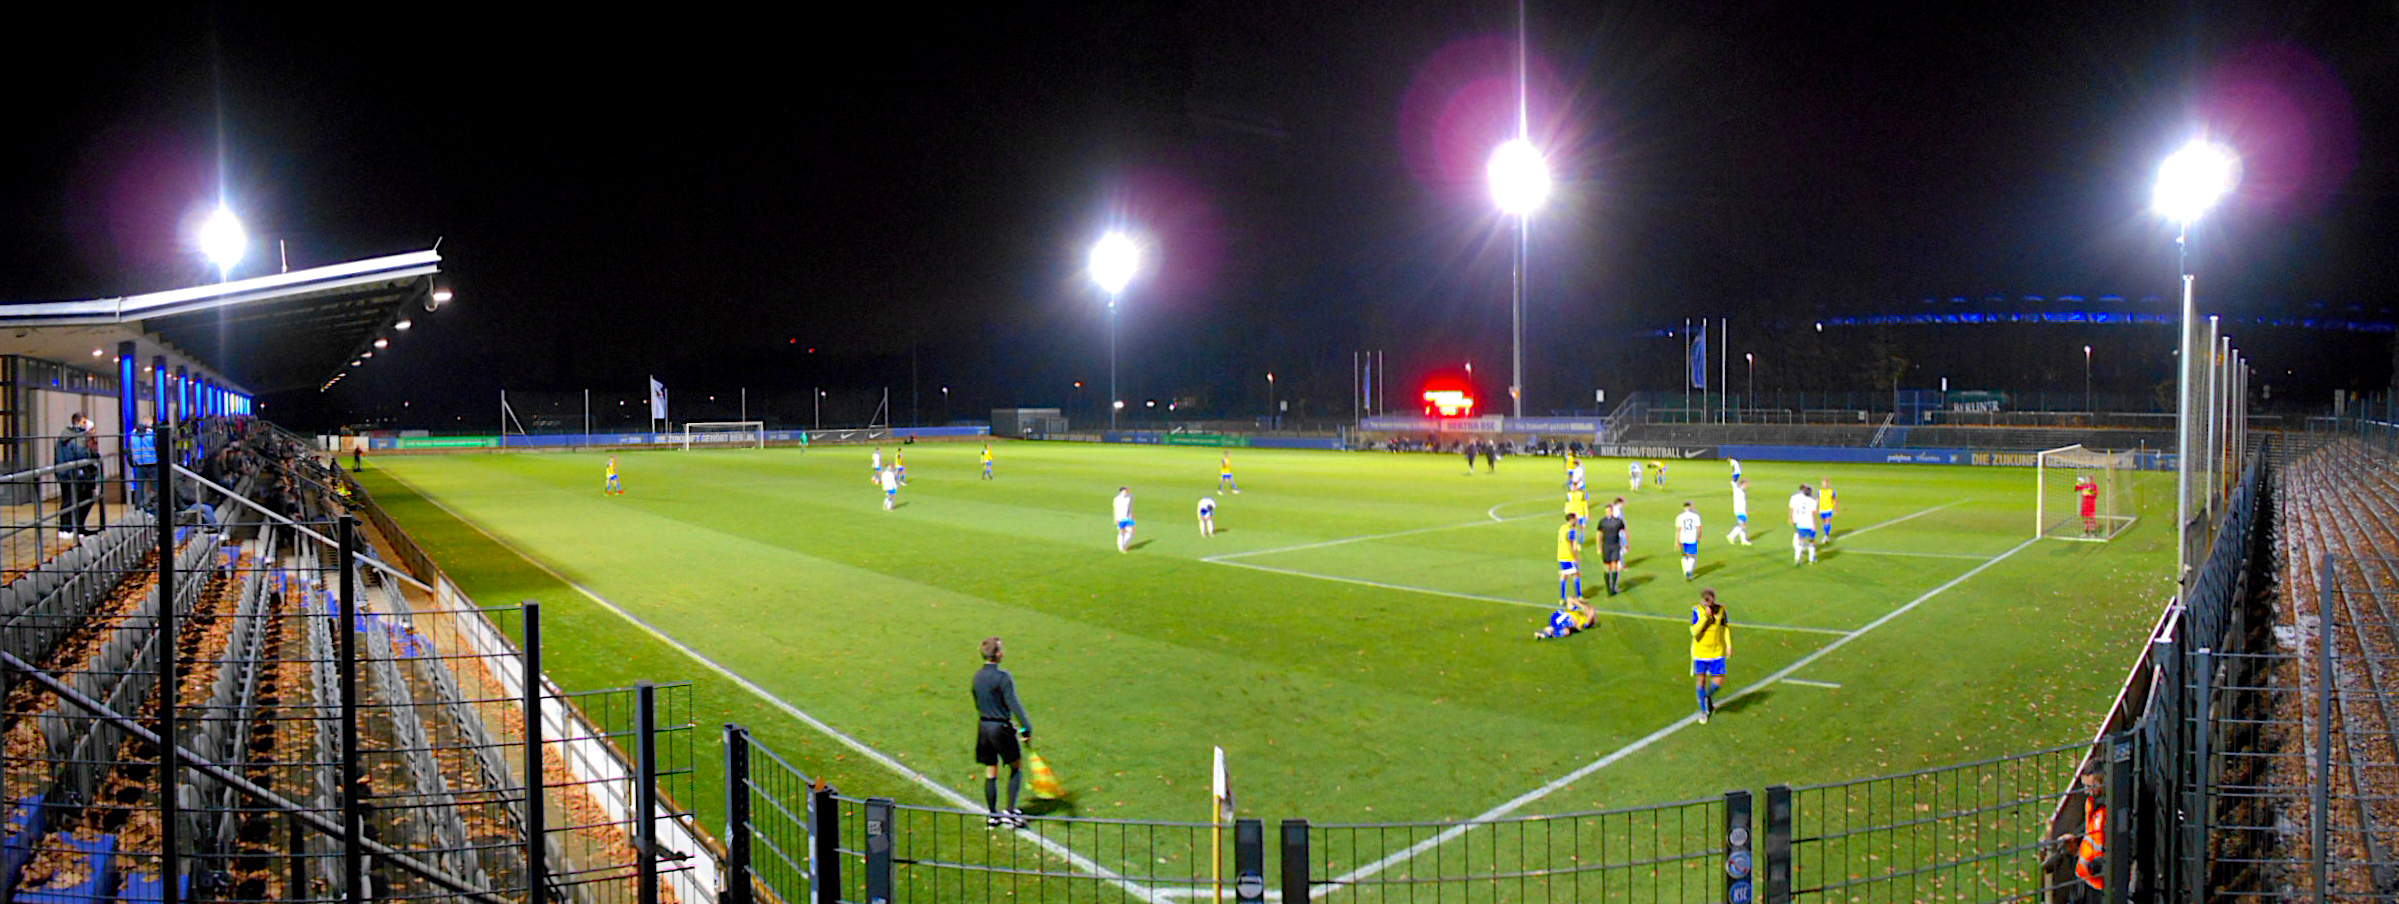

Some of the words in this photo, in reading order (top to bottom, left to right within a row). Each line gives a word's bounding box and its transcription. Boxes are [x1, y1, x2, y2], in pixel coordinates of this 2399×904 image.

[1447, 421, 1479, 430] HERTHA
[1481, 420, 1495, 430] BSC
[667, 434, 700, 444] ZUKUFT
[1601, 445, 1681, 458] NIKE.COM/FOOTBALL
[1971, 453, 1989, 466] DIE
[1992, 453, 2037, 467] ZUKUNF
[1684, 518, 1693, 531] 13
